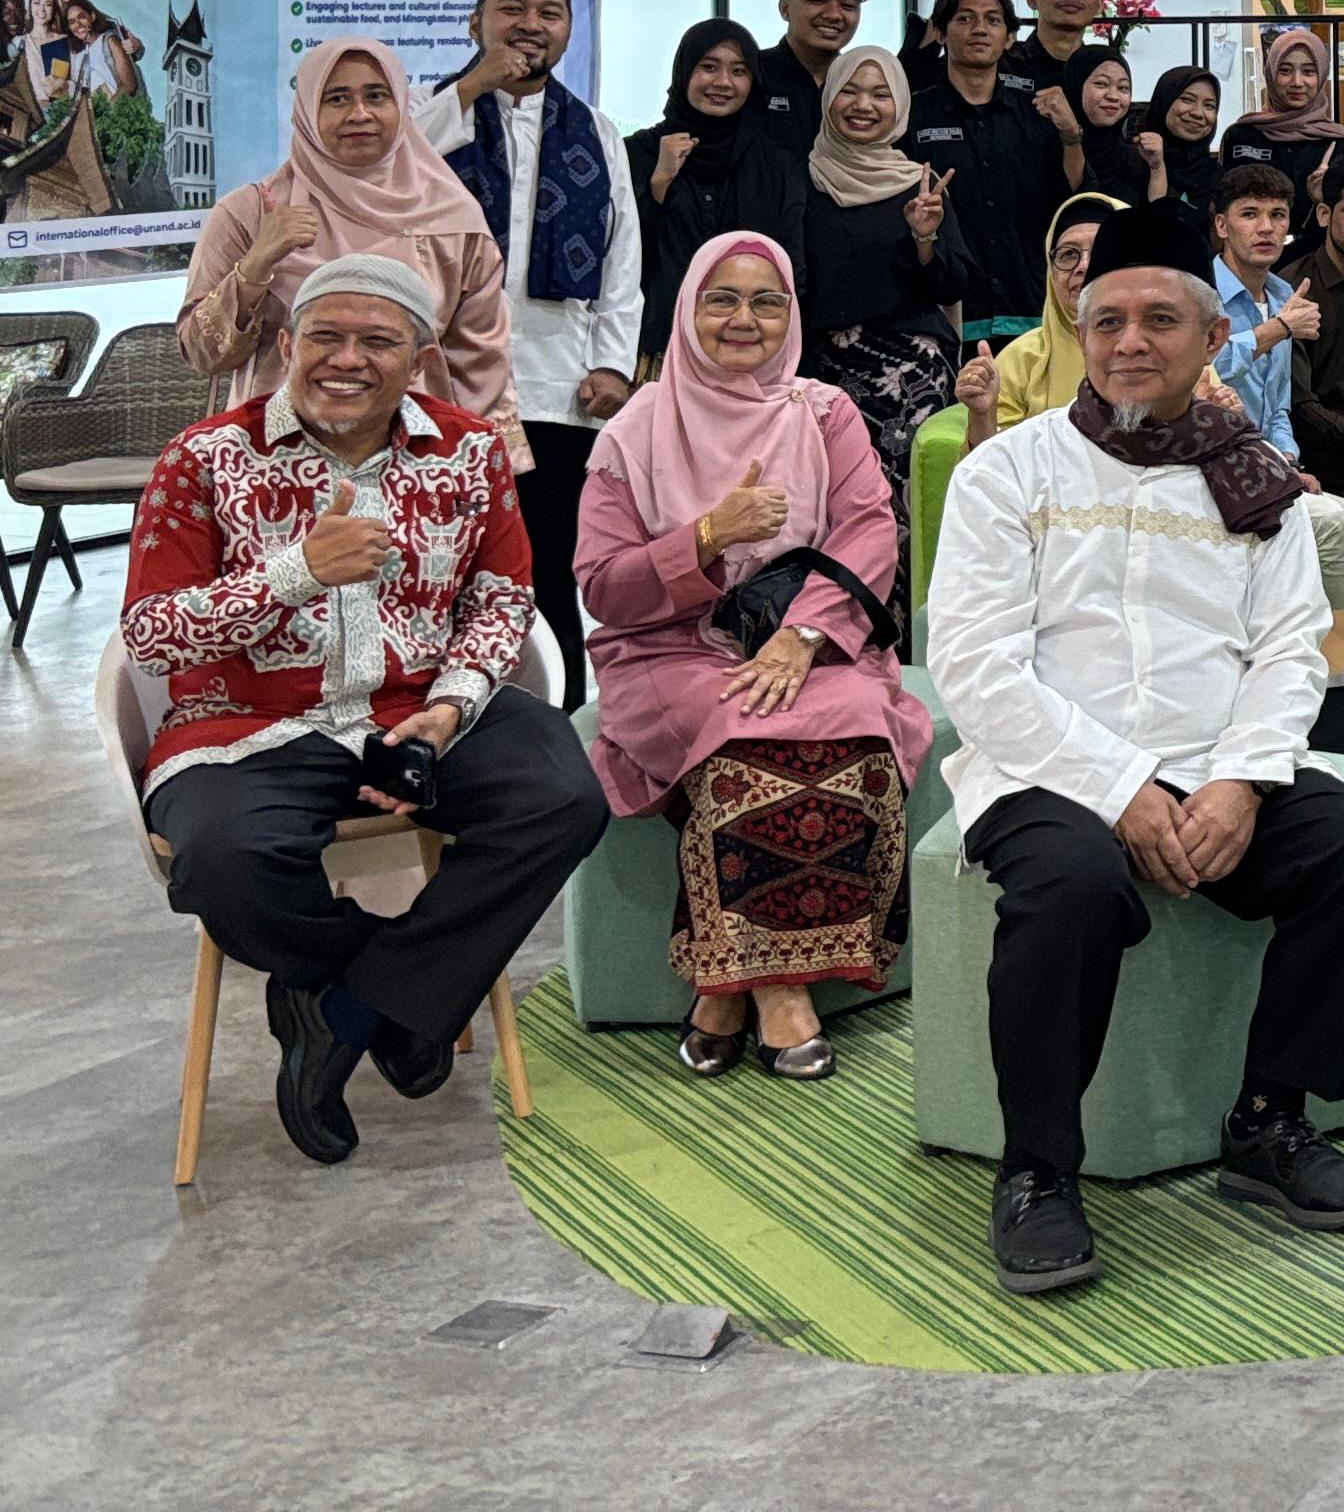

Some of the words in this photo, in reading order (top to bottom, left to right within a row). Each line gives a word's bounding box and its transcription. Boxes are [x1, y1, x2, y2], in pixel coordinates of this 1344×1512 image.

[306, 2, 349, 13] Engaging
[388, 1, 407, 11] and
[36, 220, 201, 242] internationaloffice@unand.ac.id
